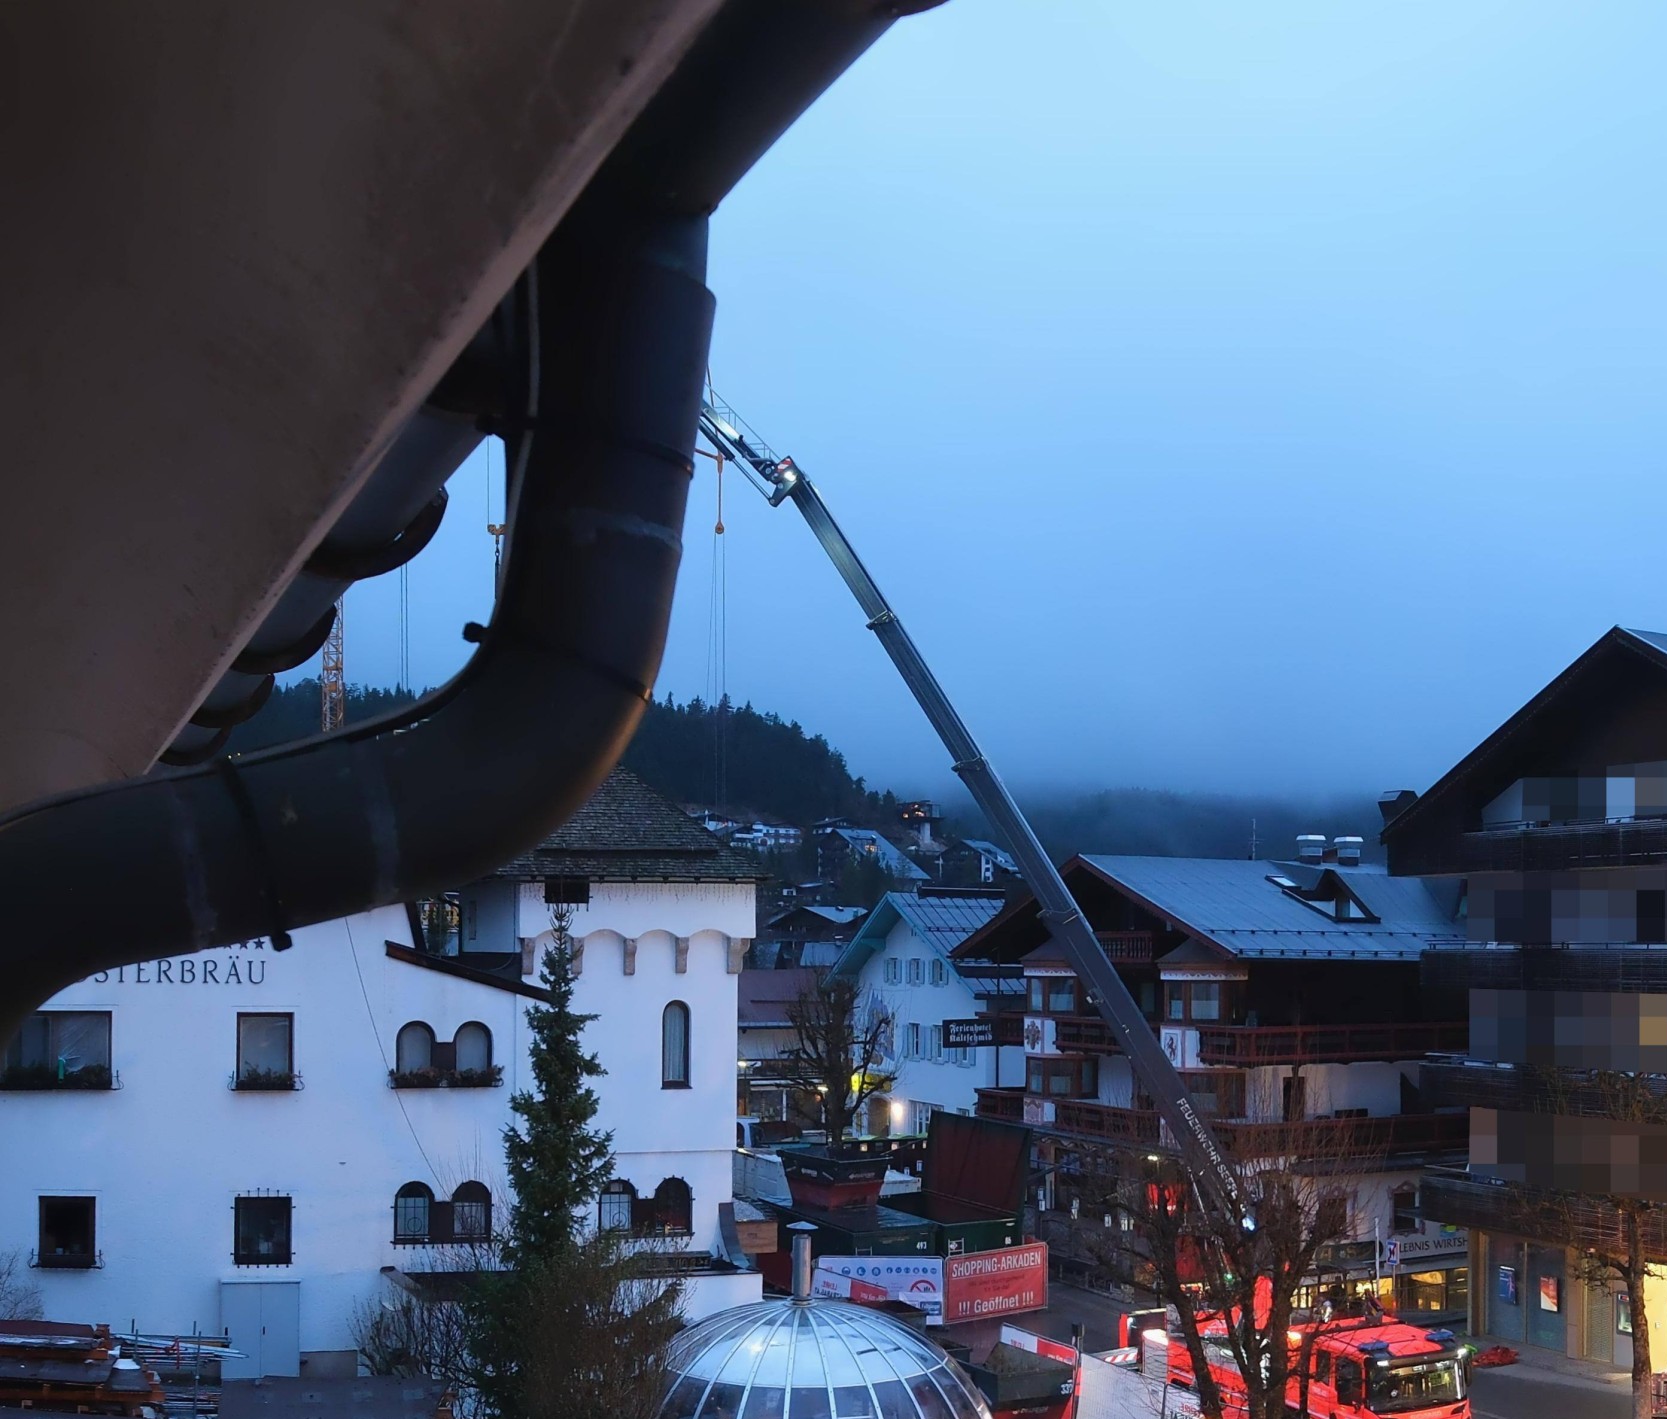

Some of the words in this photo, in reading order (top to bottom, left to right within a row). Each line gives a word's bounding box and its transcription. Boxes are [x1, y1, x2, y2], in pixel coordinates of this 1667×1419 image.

[1176, 1097, 1221, 1165] FEUERWEHR
[916, 1241, 928, 1250] 493
[952, 1251, 1041, 1278] SHOPPING-ARKADEN
[974, 1293, 1020, 1313] Geöffnet
